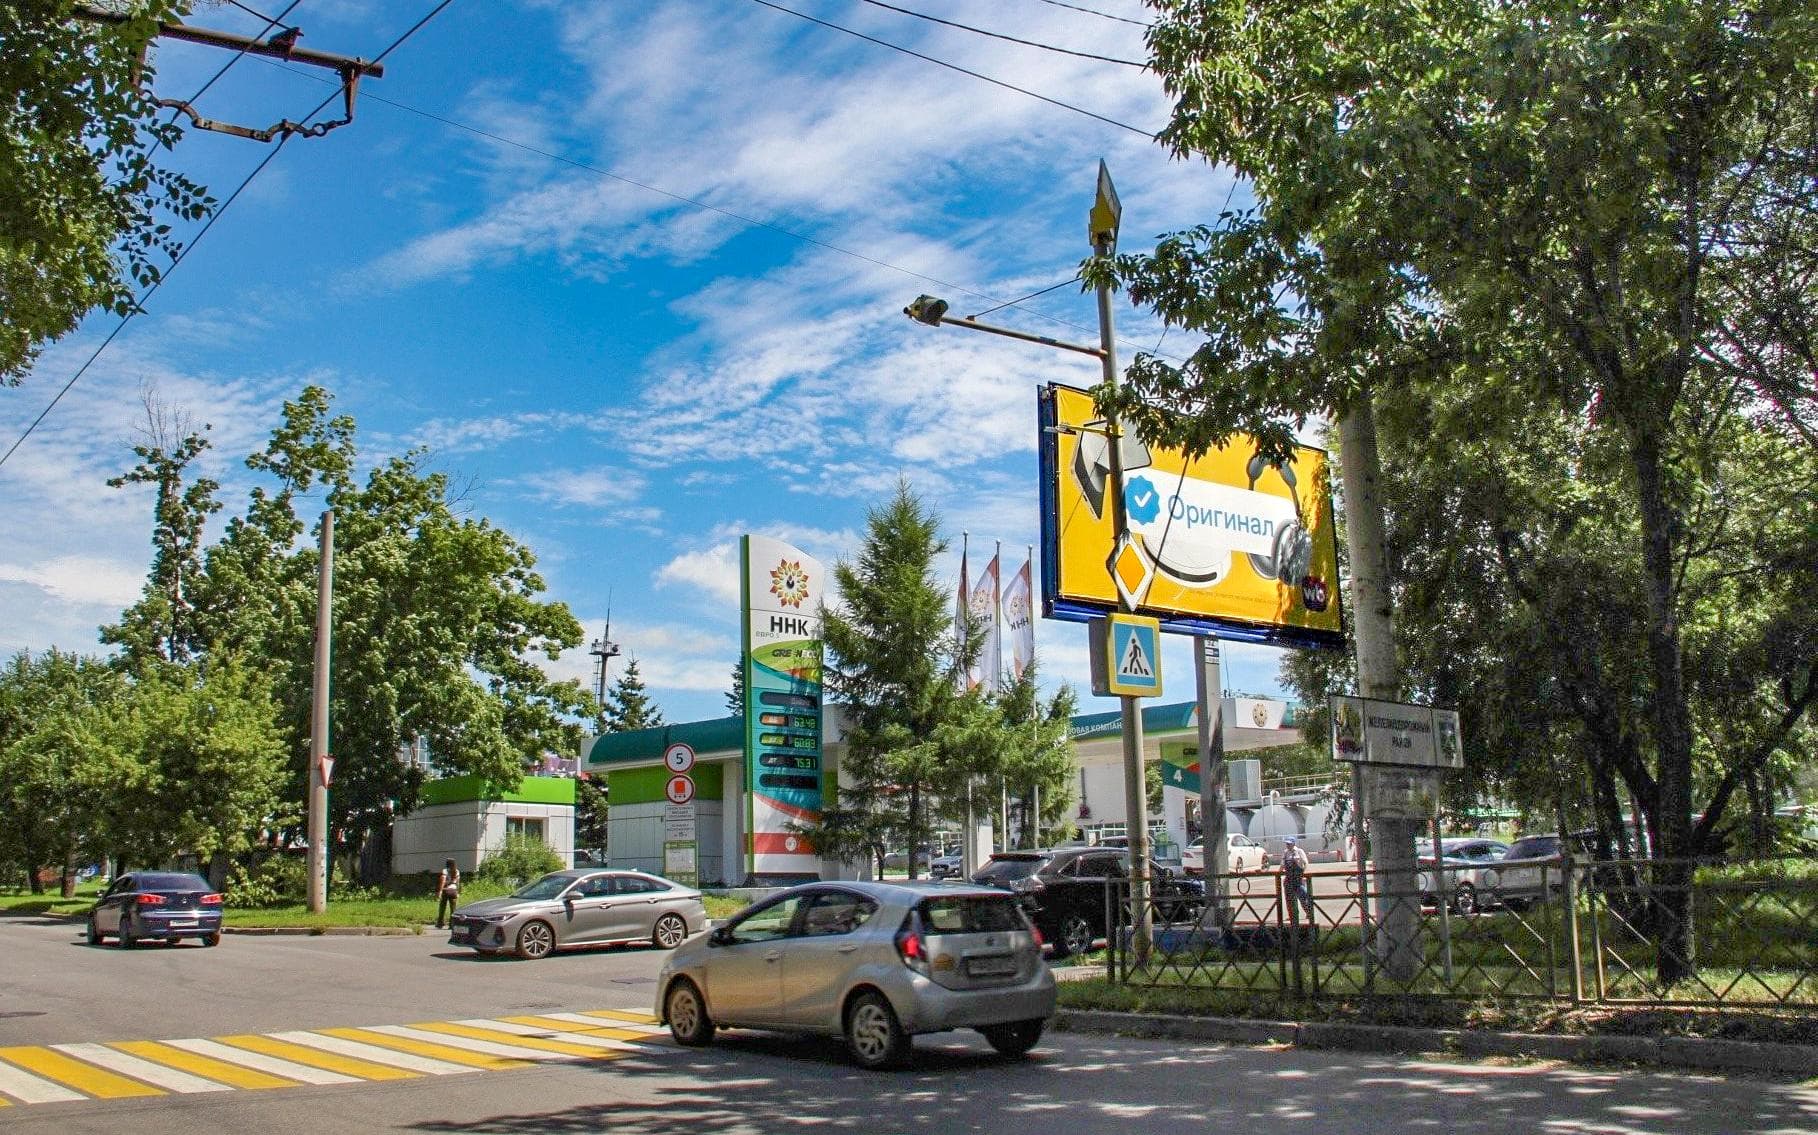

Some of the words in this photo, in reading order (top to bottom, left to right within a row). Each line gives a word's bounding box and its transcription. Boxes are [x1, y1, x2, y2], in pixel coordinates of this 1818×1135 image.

[1168, 494, 1275, 538] Оригинал
[770, 615, 809, 637] ННК
[675, 752, 684, 765] 5
[1173, 769, 1183, 782] 4
